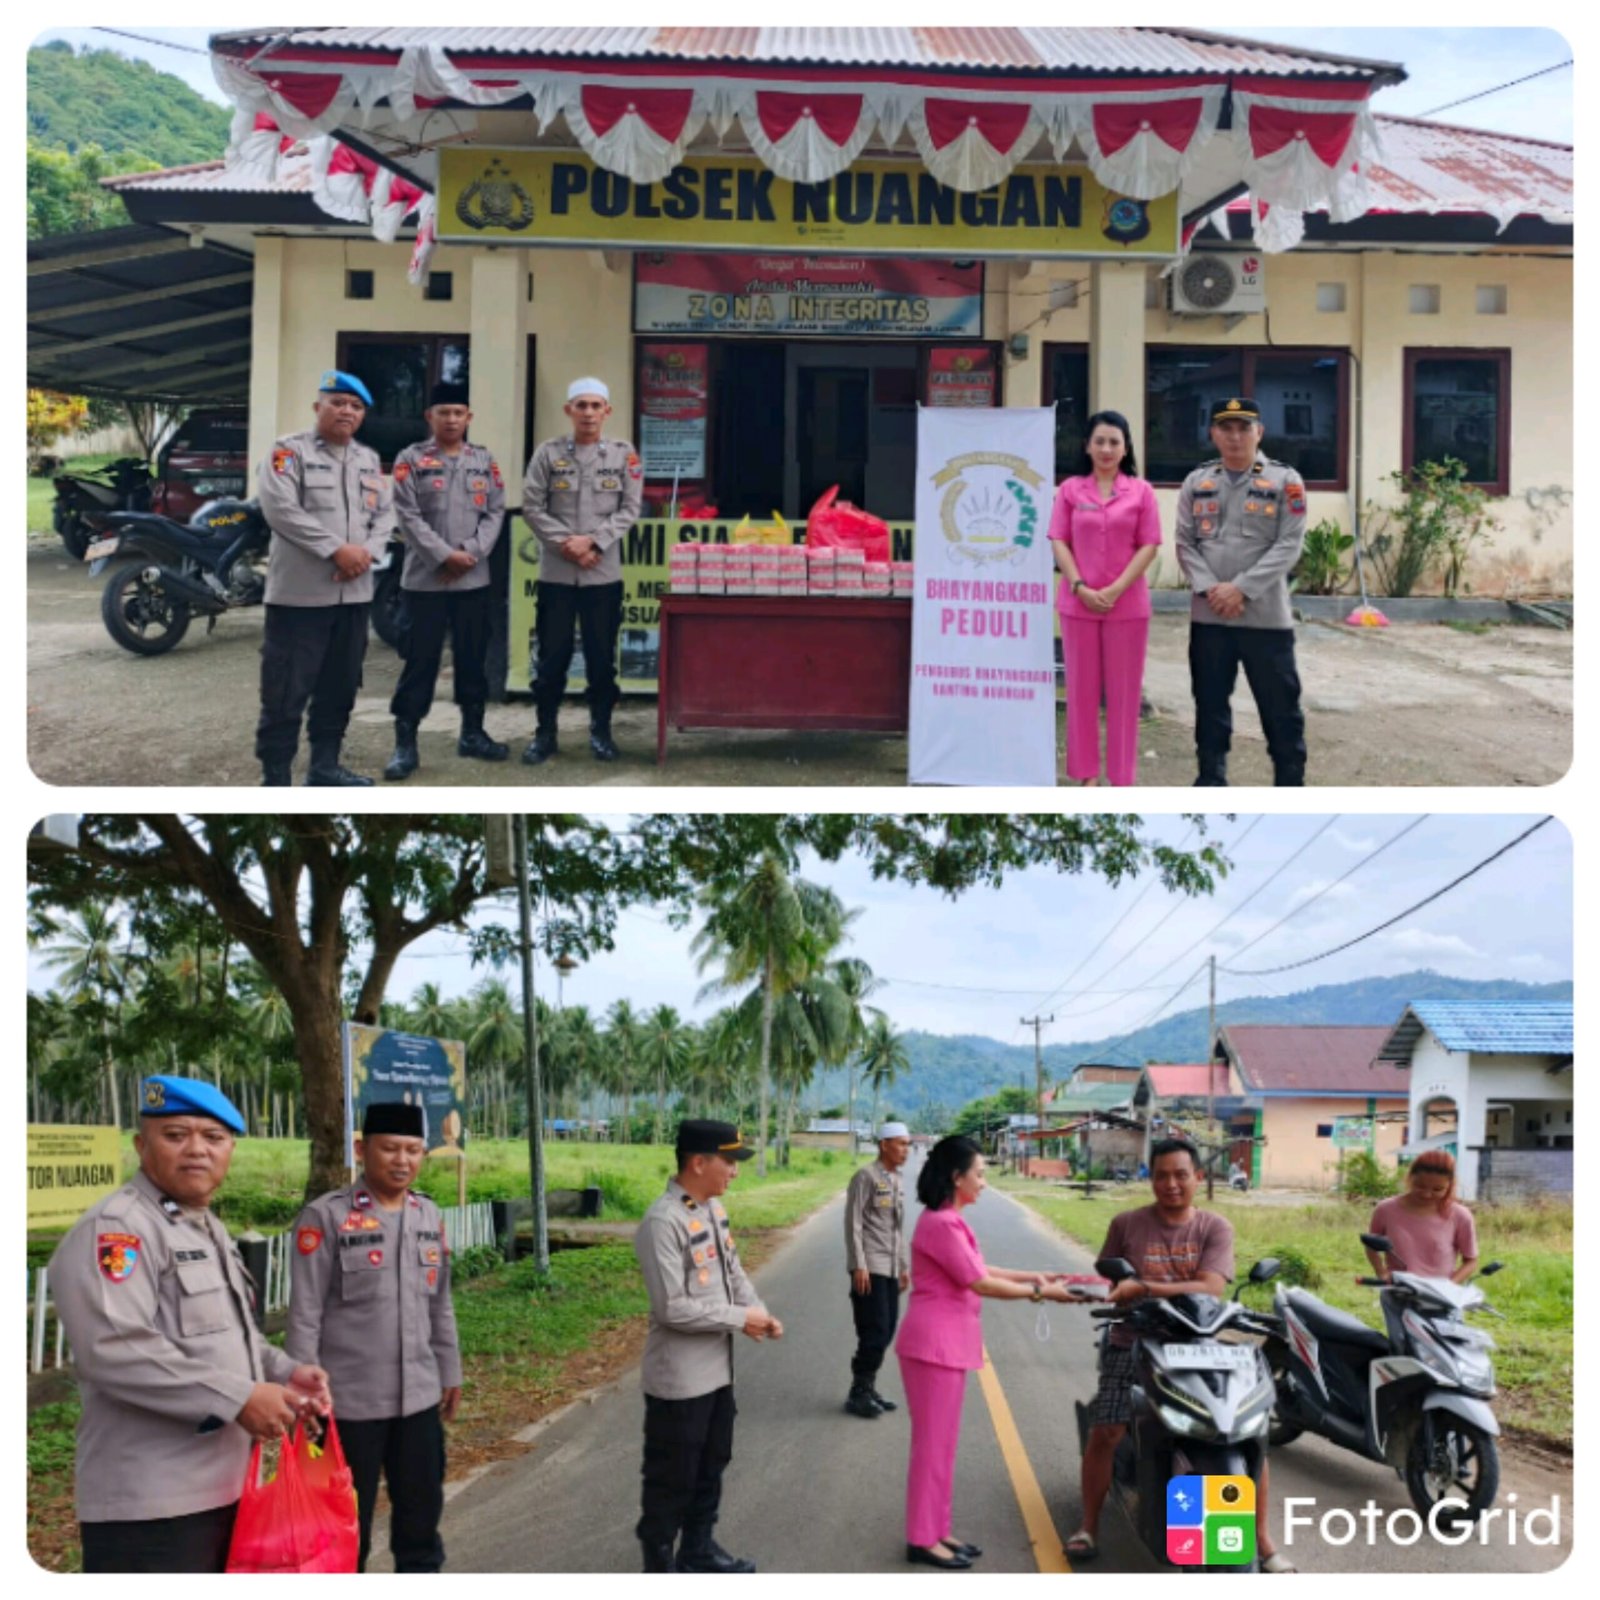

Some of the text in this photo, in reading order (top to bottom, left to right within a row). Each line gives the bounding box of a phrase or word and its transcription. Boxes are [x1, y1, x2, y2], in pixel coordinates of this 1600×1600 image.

[550, 162, 1082, 228] POLSEK NUANGAN
[1241, 276, 1257, 285] LG
[687, 295, 930, 323] ZONA INTEGRITAS
[926, 578, 1047, 604] BHAYANGKARI
[940, 607, 1028, 639] PEDULI
[57, 1164, 115, 1188] NUANGAN
